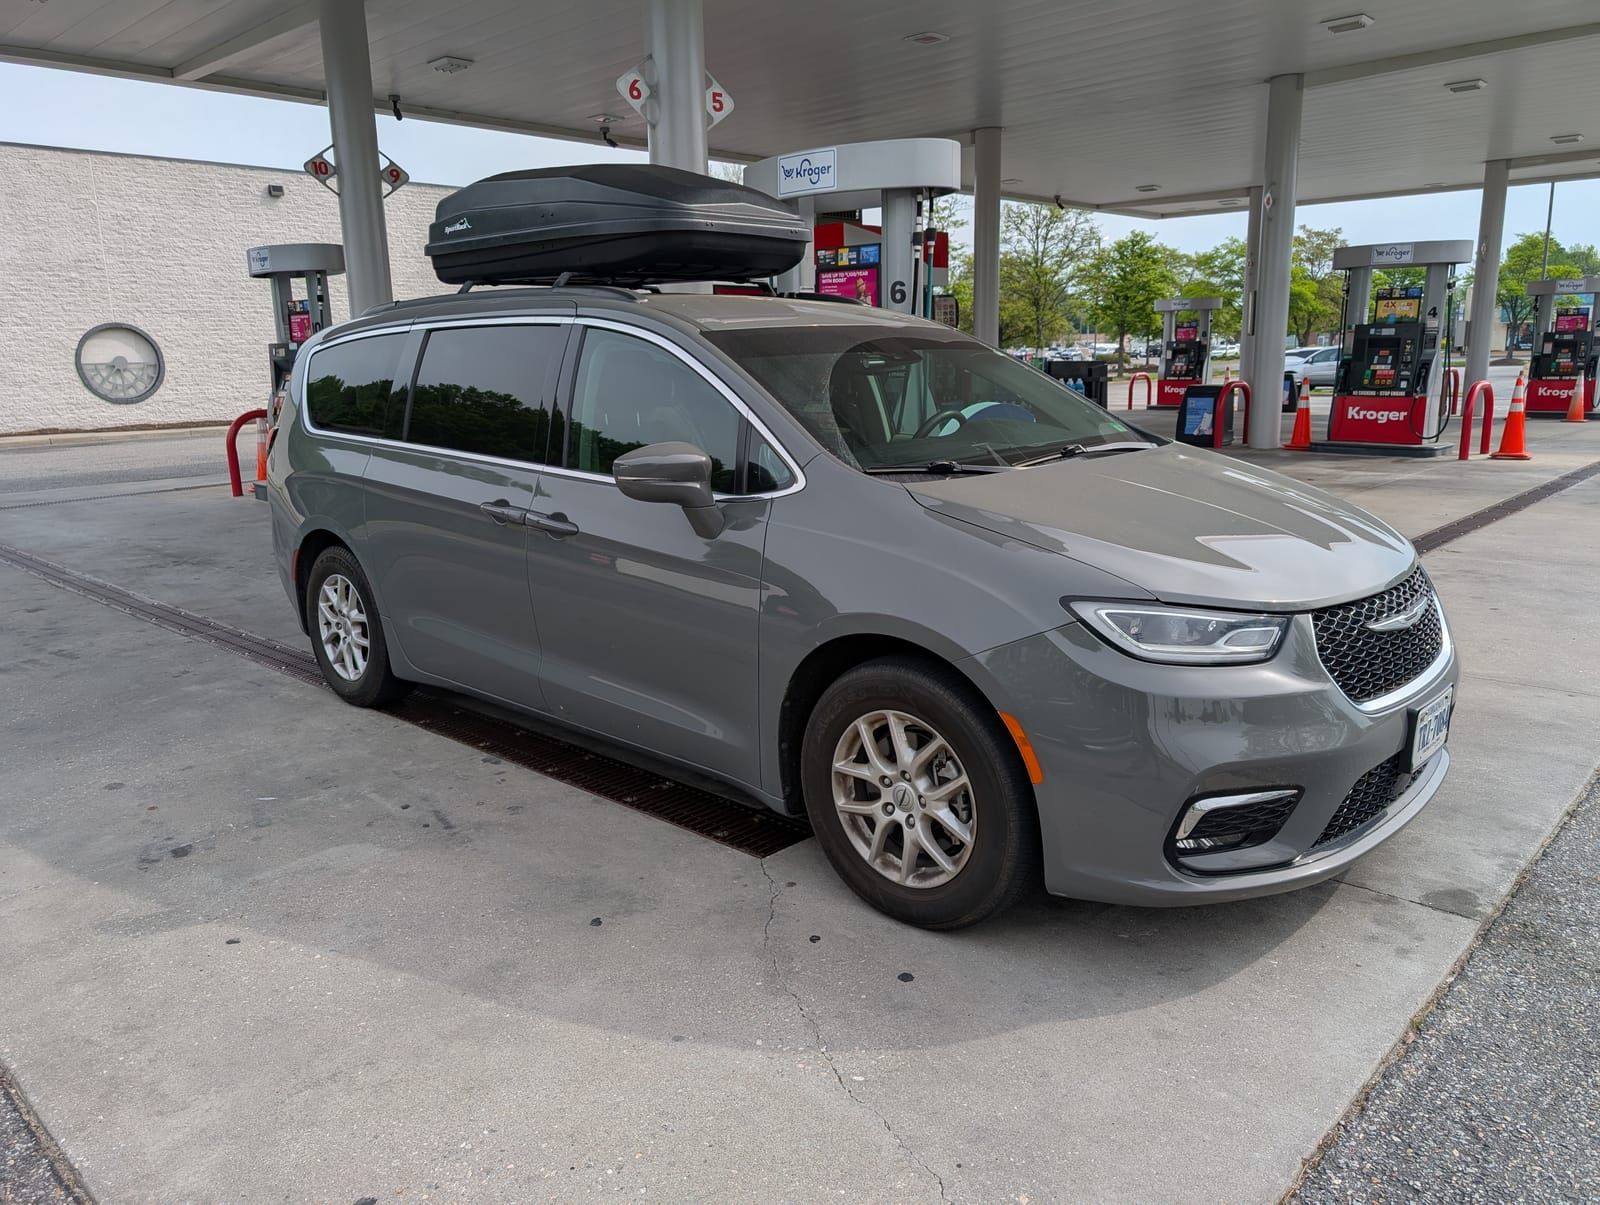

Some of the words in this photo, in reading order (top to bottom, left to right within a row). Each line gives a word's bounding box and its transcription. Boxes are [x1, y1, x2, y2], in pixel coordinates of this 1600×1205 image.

[629, 79, 641, 100] 6
[712, 91, 724, 112] 5
[312, 161, 329, 176] 10
[389, 168, 400, 183] 9
[796, 158, 832, 185] Kroger
[1386, 247, 1410, 260] Kroger
[890, 280, 907, 304] 6
[1427, 306, 1438, 318] 4
[1164, 385, 1187, 395] Krog
[1538, 387, 1575, 398] Kroge
[1347, 406, 1408, 423] Kroger
